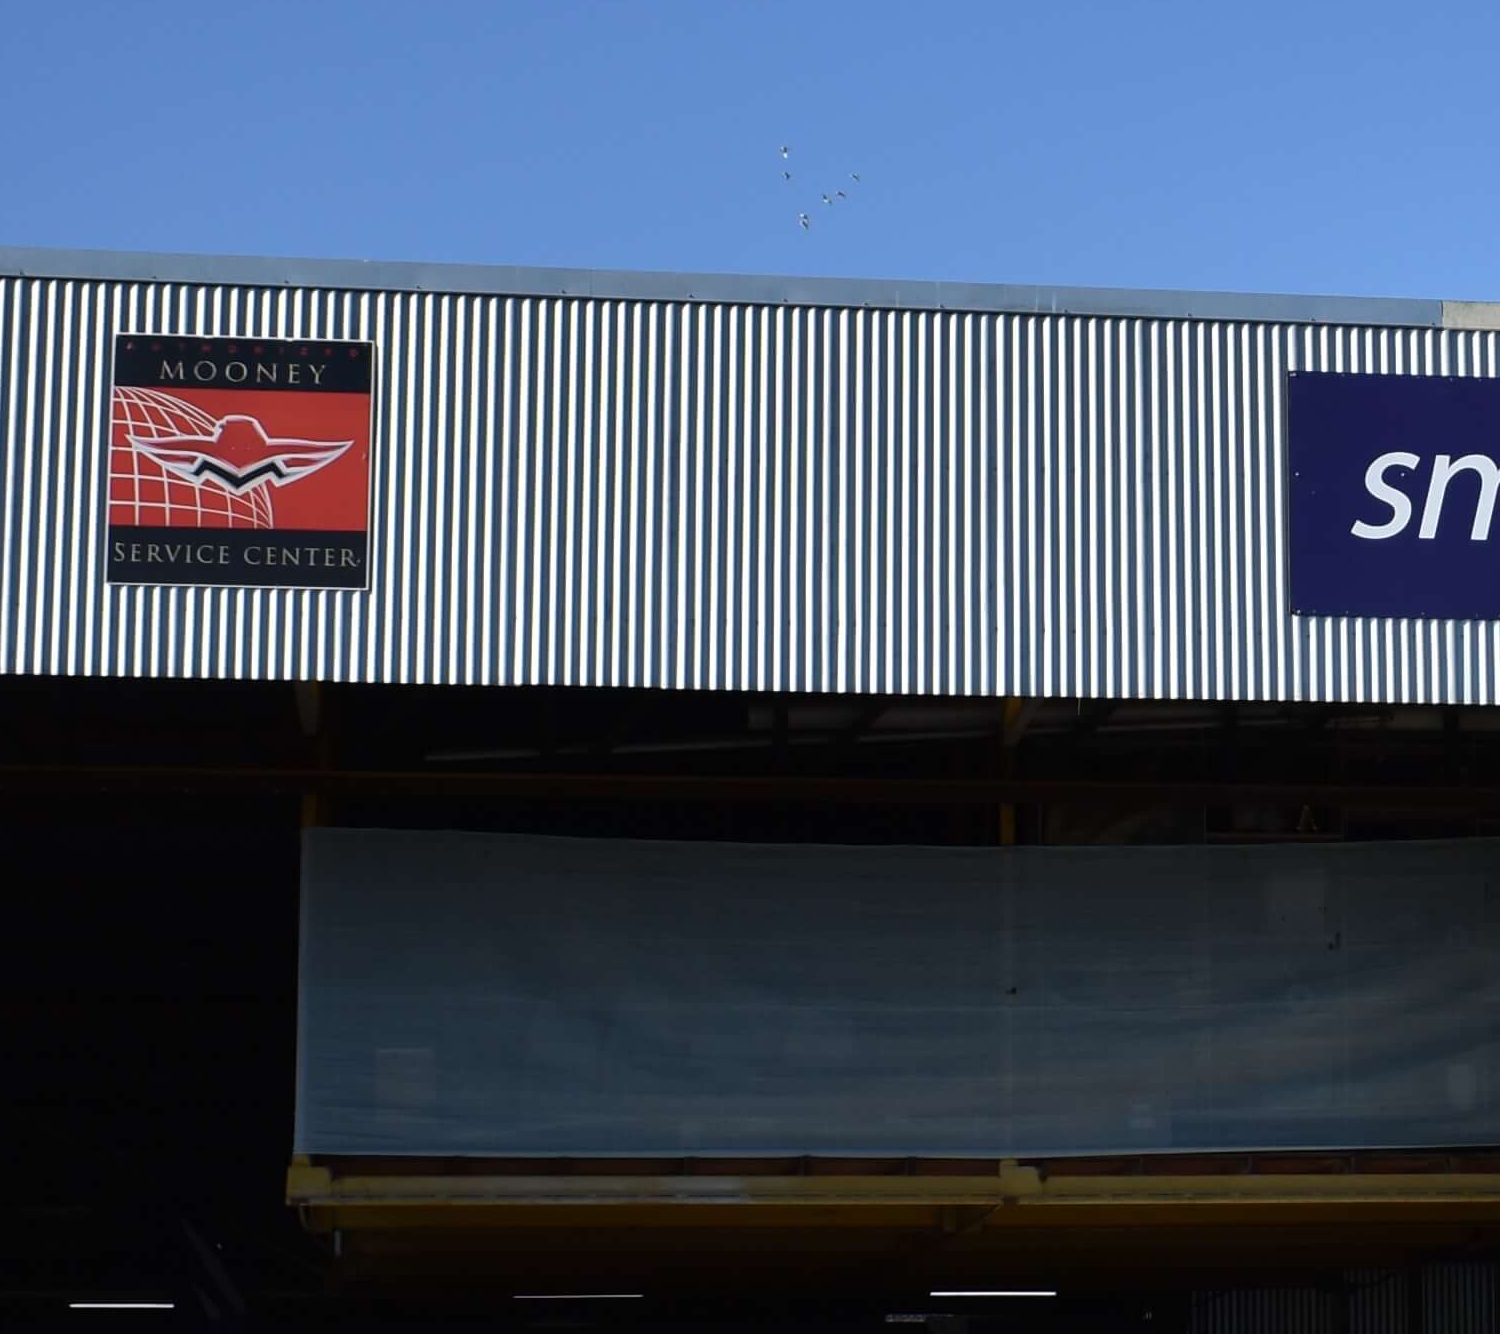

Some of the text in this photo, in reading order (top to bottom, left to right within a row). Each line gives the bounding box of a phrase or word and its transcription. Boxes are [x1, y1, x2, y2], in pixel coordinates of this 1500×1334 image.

[159, 359, 327, 385] MOONEY
[112, 541, 359, 569] SERVICE CENTER
